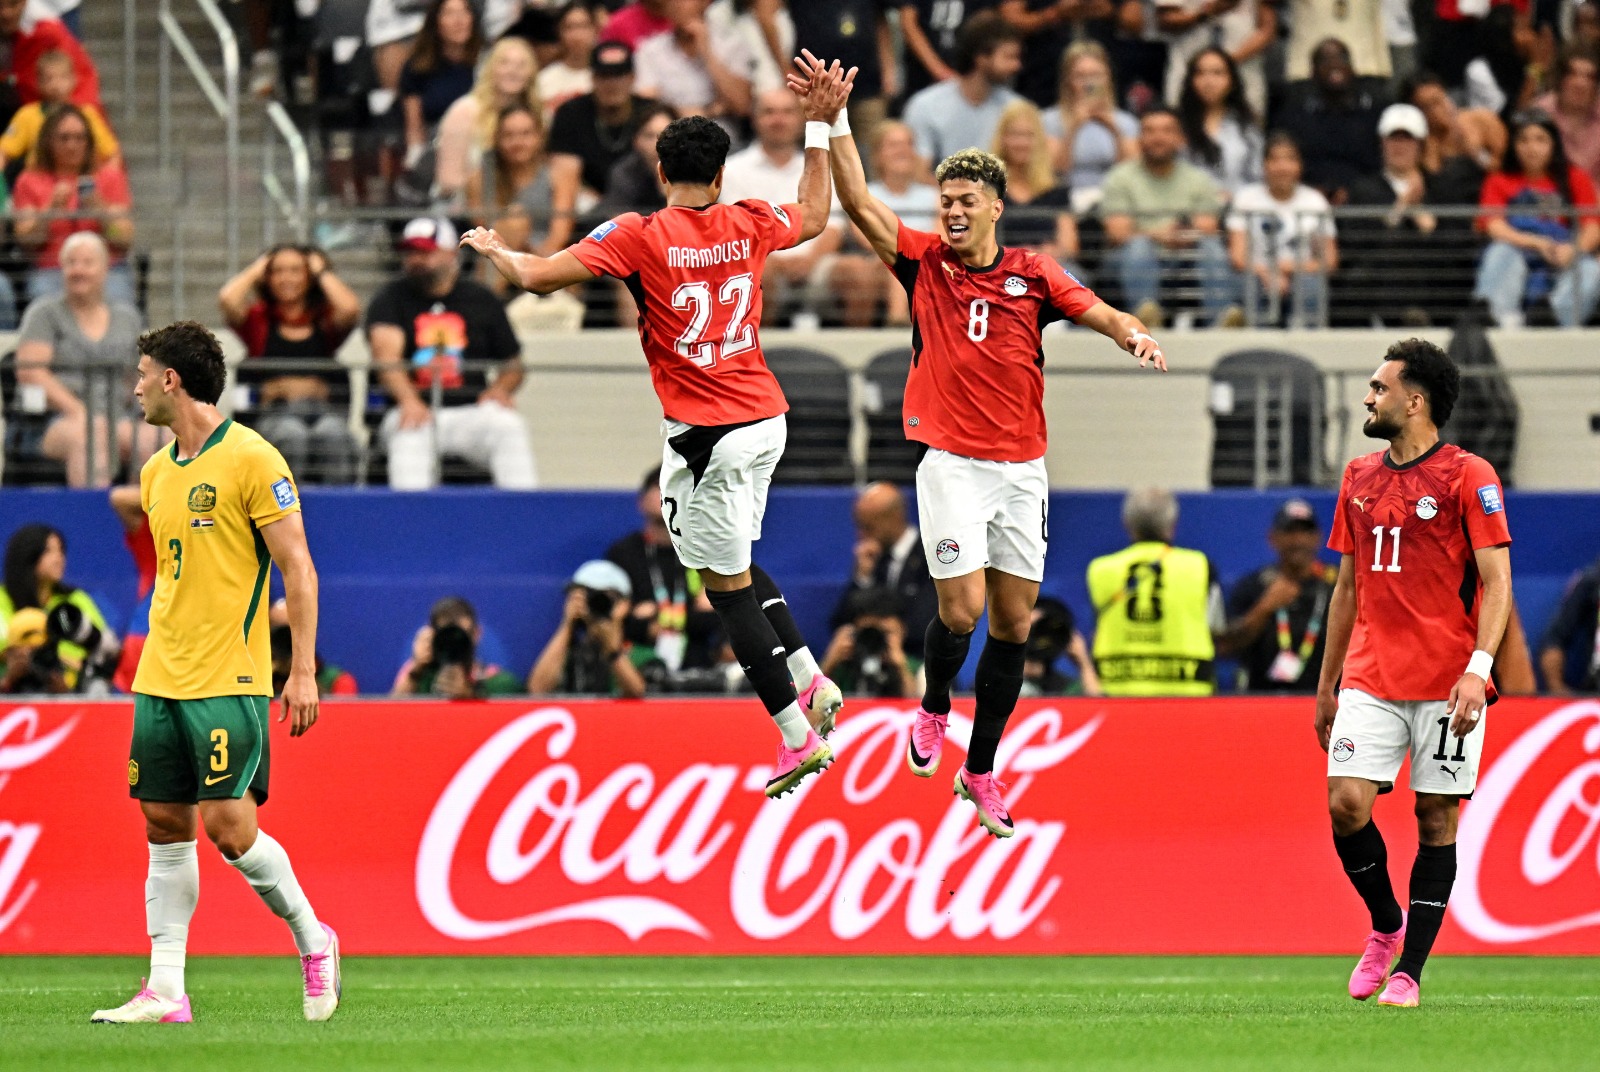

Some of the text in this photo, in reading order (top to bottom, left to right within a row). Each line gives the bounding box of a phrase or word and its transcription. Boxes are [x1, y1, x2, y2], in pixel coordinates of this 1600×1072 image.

[668, 239, 750, 269] MARMOUSH
[672, 272, 757, 371] 22
[968, 299, 989, 342] 8
[661, 497, 682, 537] 2
[169, 538, 182, 581] 3
[1371, 525, 1402, 573] 11
[210, 728, 229, 772] 3
[1432, 717, 1466, 762] 11
[414, 706, 1104, 942] Coca-Cola
